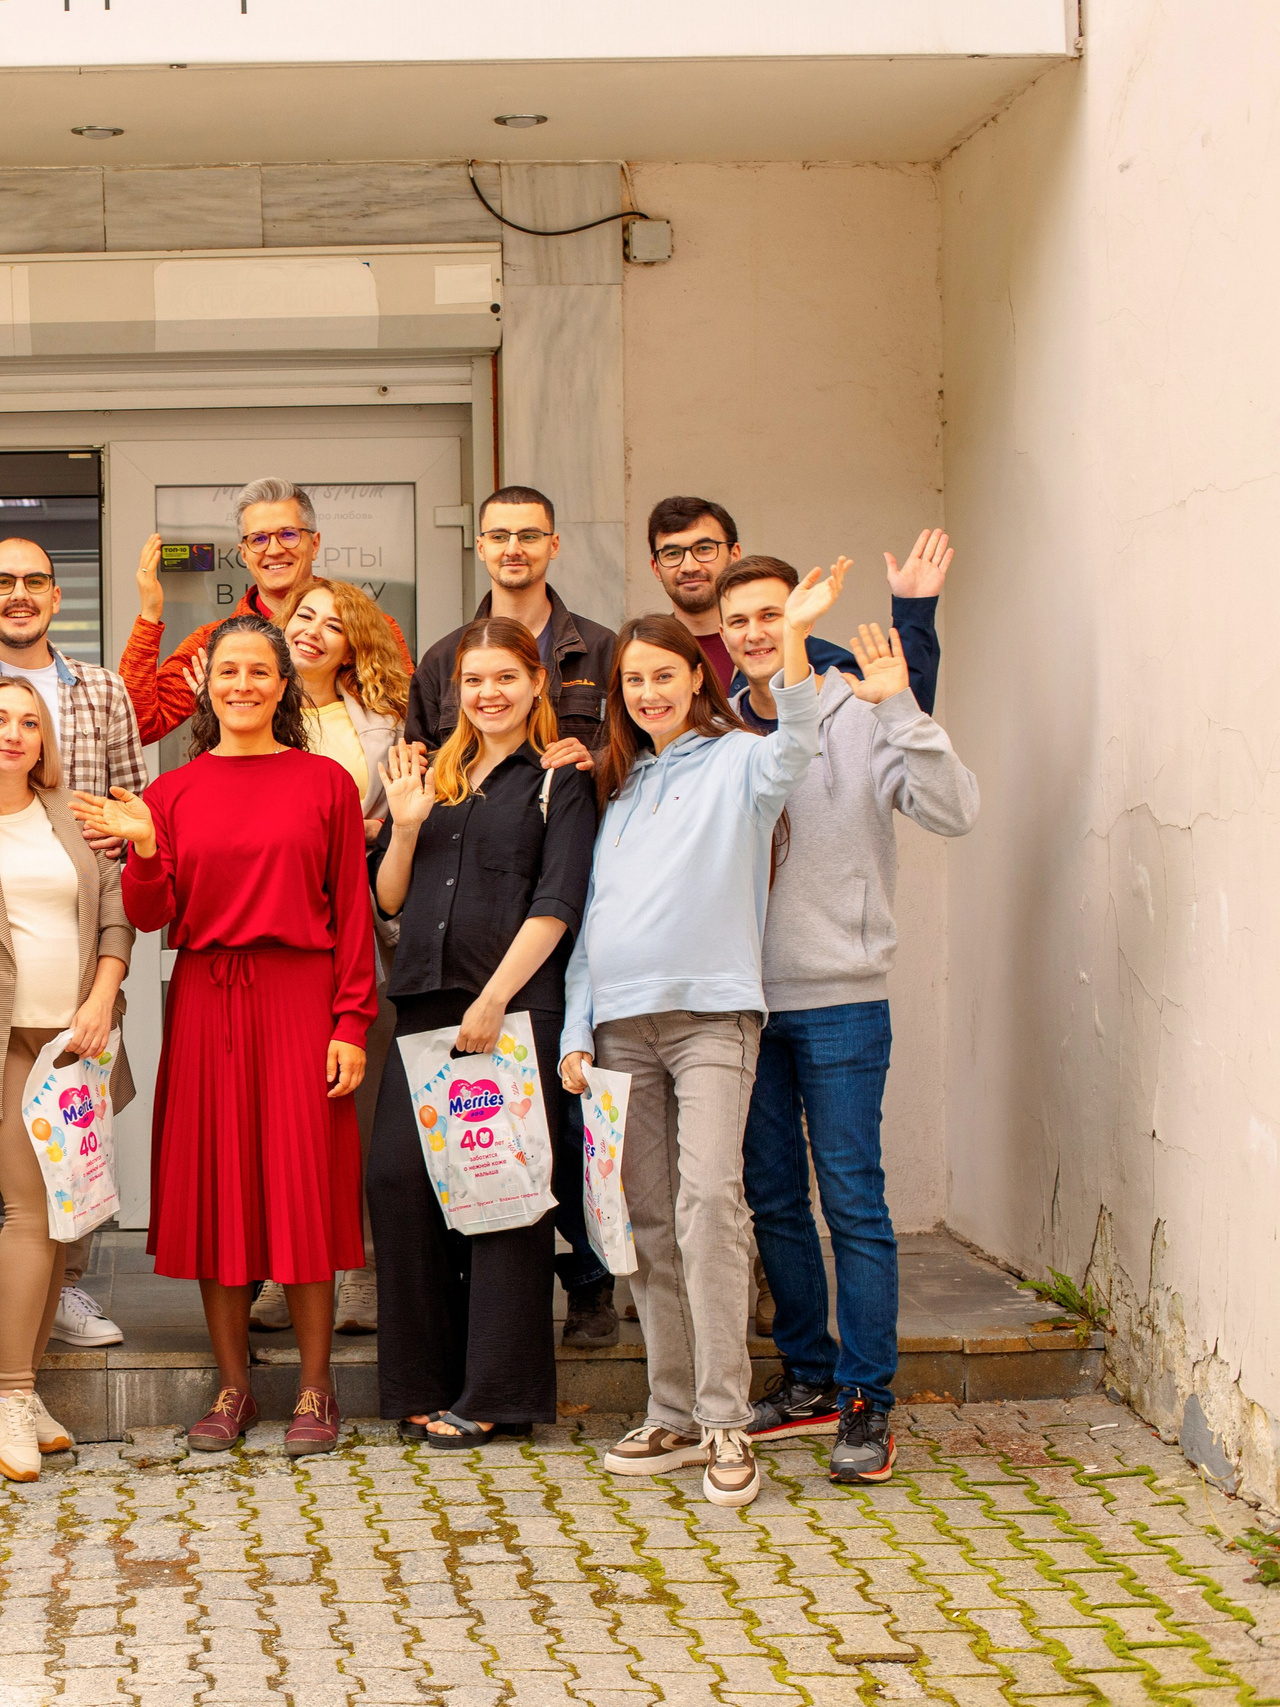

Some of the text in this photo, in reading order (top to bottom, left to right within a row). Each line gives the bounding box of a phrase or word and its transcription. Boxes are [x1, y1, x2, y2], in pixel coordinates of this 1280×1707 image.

[217, 583, 234, 604] В
[449, 1090, 504, 1116] Merries
[80, 1131, 97, 1157] 40
[460, 1127, 494, 1151] 40
